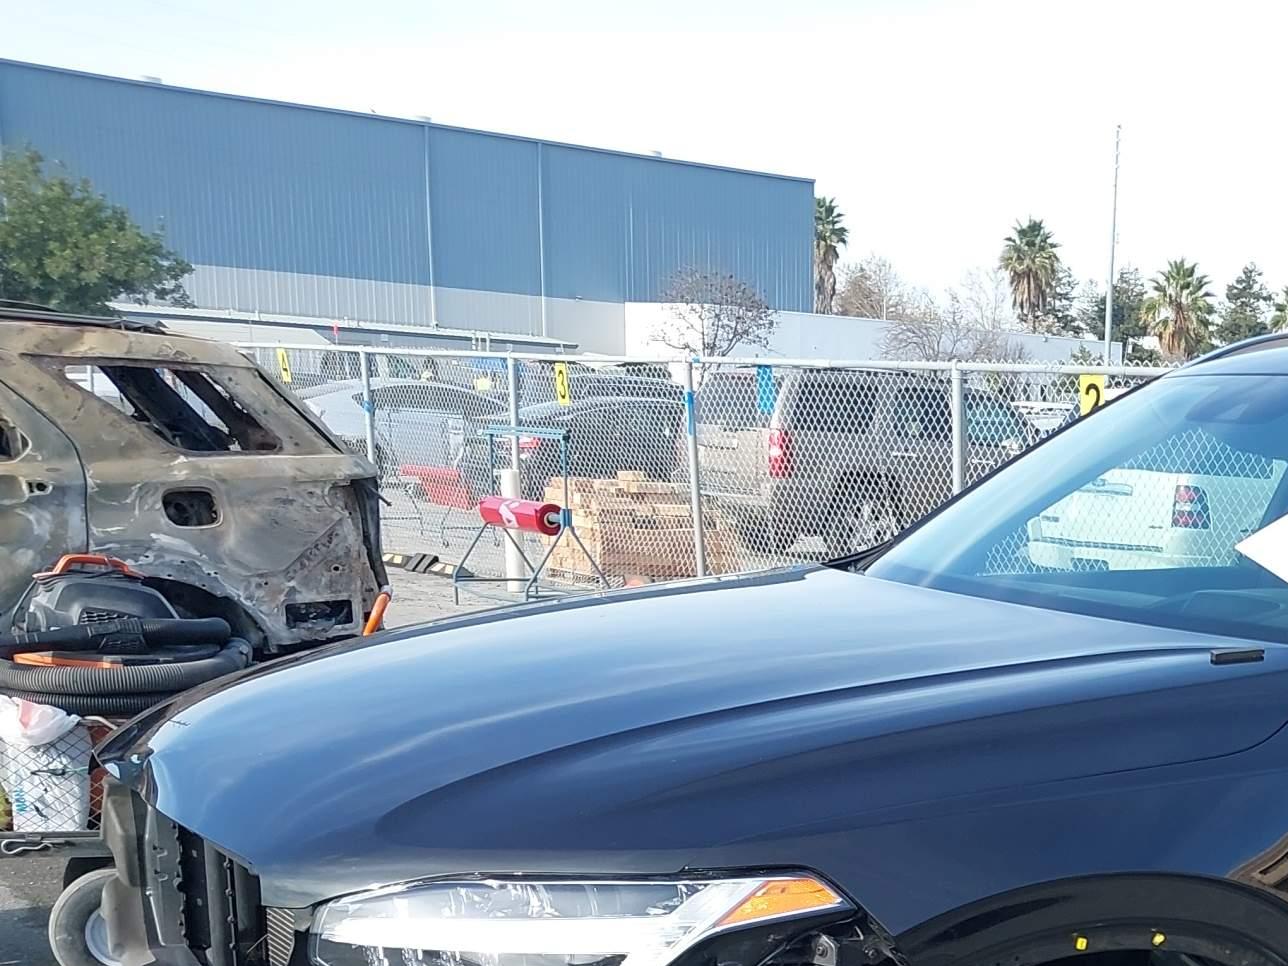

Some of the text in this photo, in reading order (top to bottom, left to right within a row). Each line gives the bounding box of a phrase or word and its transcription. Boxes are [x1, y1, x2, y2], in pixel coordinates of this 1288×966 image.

[281, 351, 290, 379] 4
[557, 369, 567, 400] 3
[1085, 382, 1101, 416] 2
